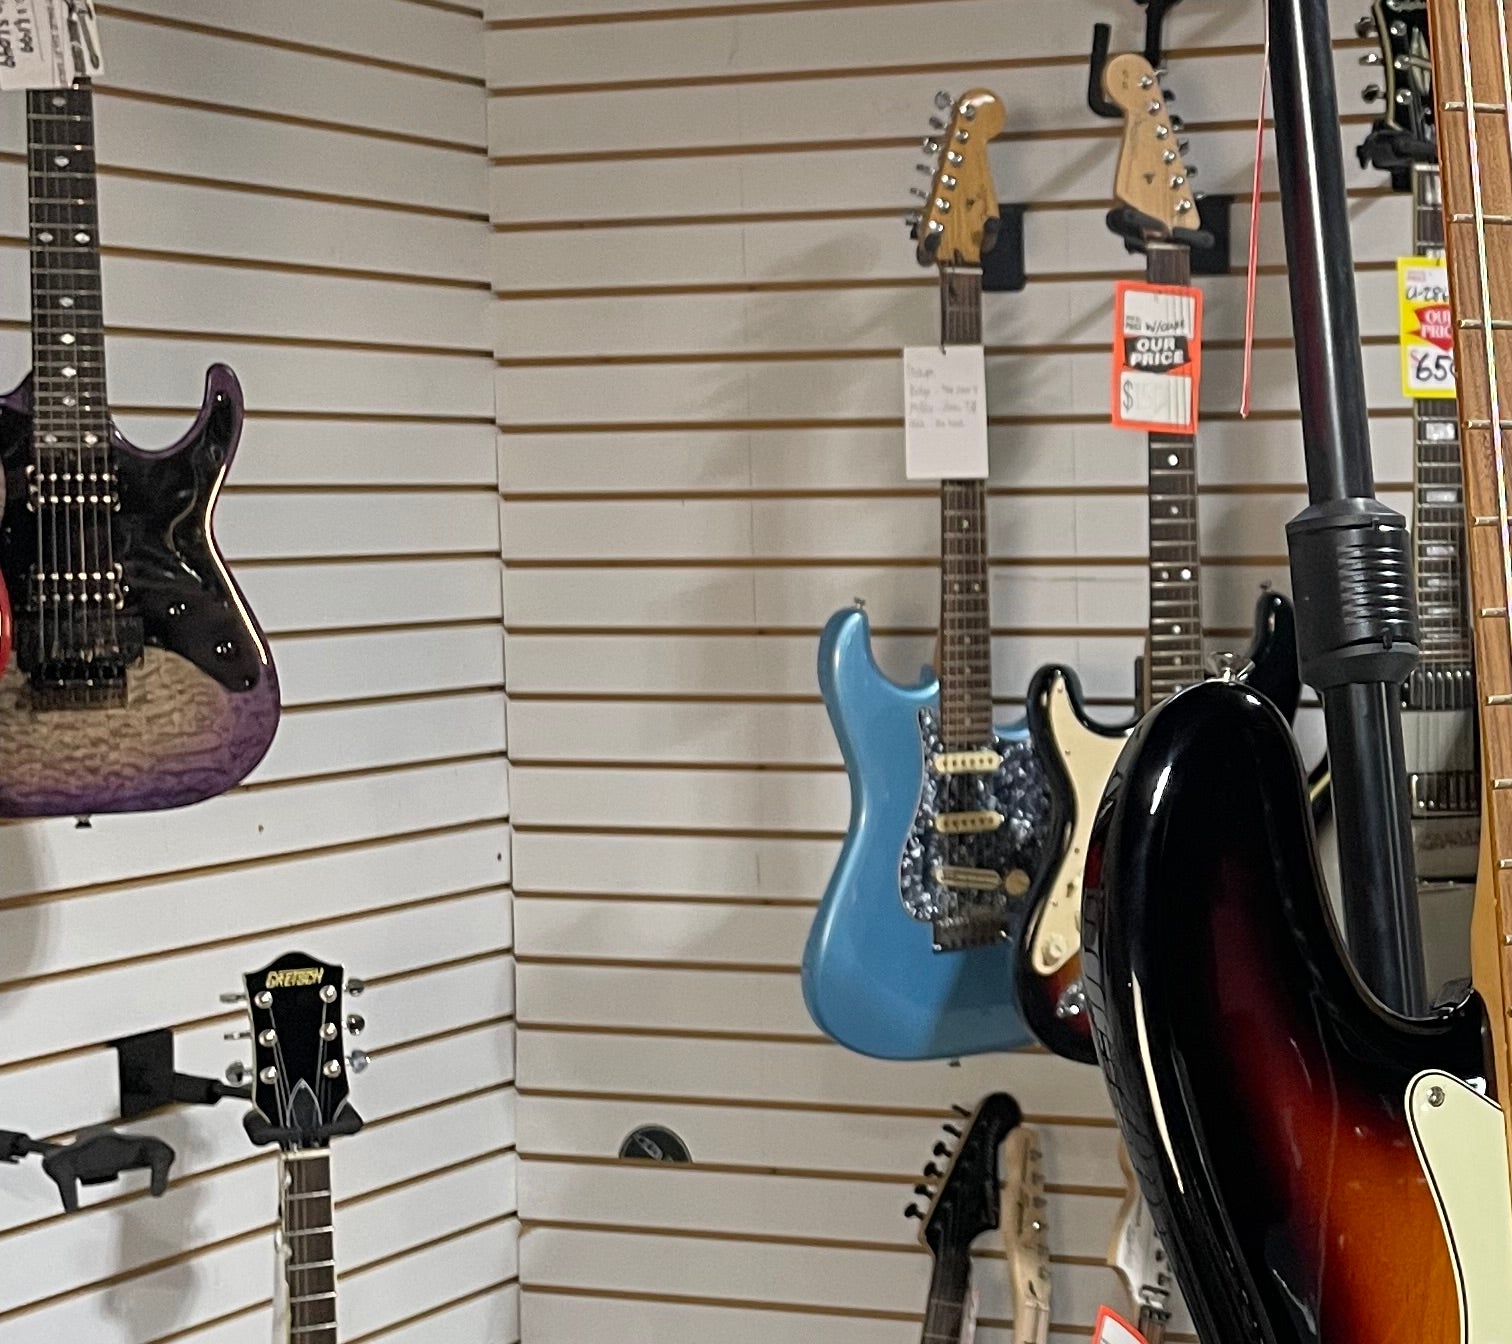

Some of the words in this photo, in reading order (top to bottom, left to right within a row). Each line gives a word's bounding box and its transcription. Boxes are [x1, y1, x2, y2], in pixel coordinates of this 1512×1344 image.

[1421, 324, 1453, 339] PRIC
[1136, 337, 1176, 352] OUR
[1130, 349, 1185, 366] PRICE
[266, 967, 325, 989] GRETSCH
